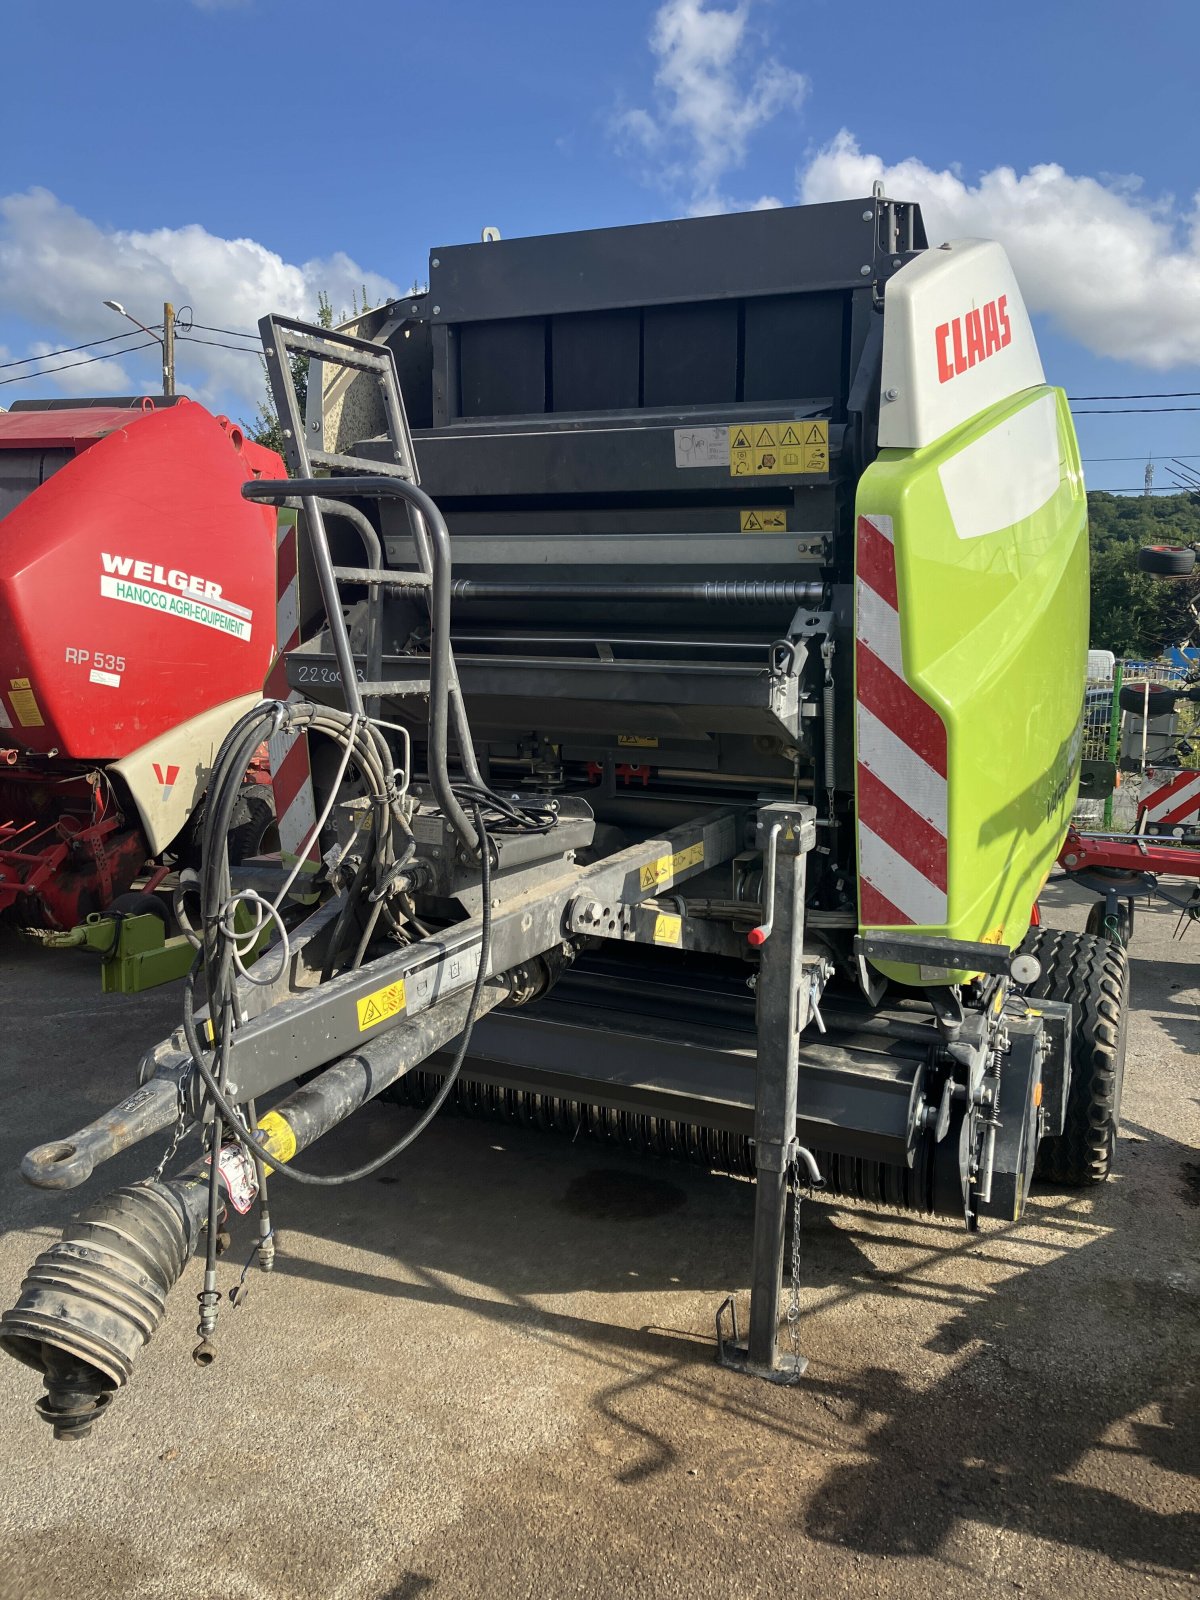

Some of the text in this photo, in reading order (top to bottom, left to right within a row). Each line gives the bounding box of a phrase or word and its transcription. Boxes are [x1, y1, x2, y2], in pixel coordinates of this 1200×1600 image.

[935, 294, 1011, 384] CLAAS
[101, 552, 223, 601] WELGER
[116, 582, 245, 636] HANOCQ AGRI-EQUIPEMENT
[65, 647, 126, 672] RP 535
